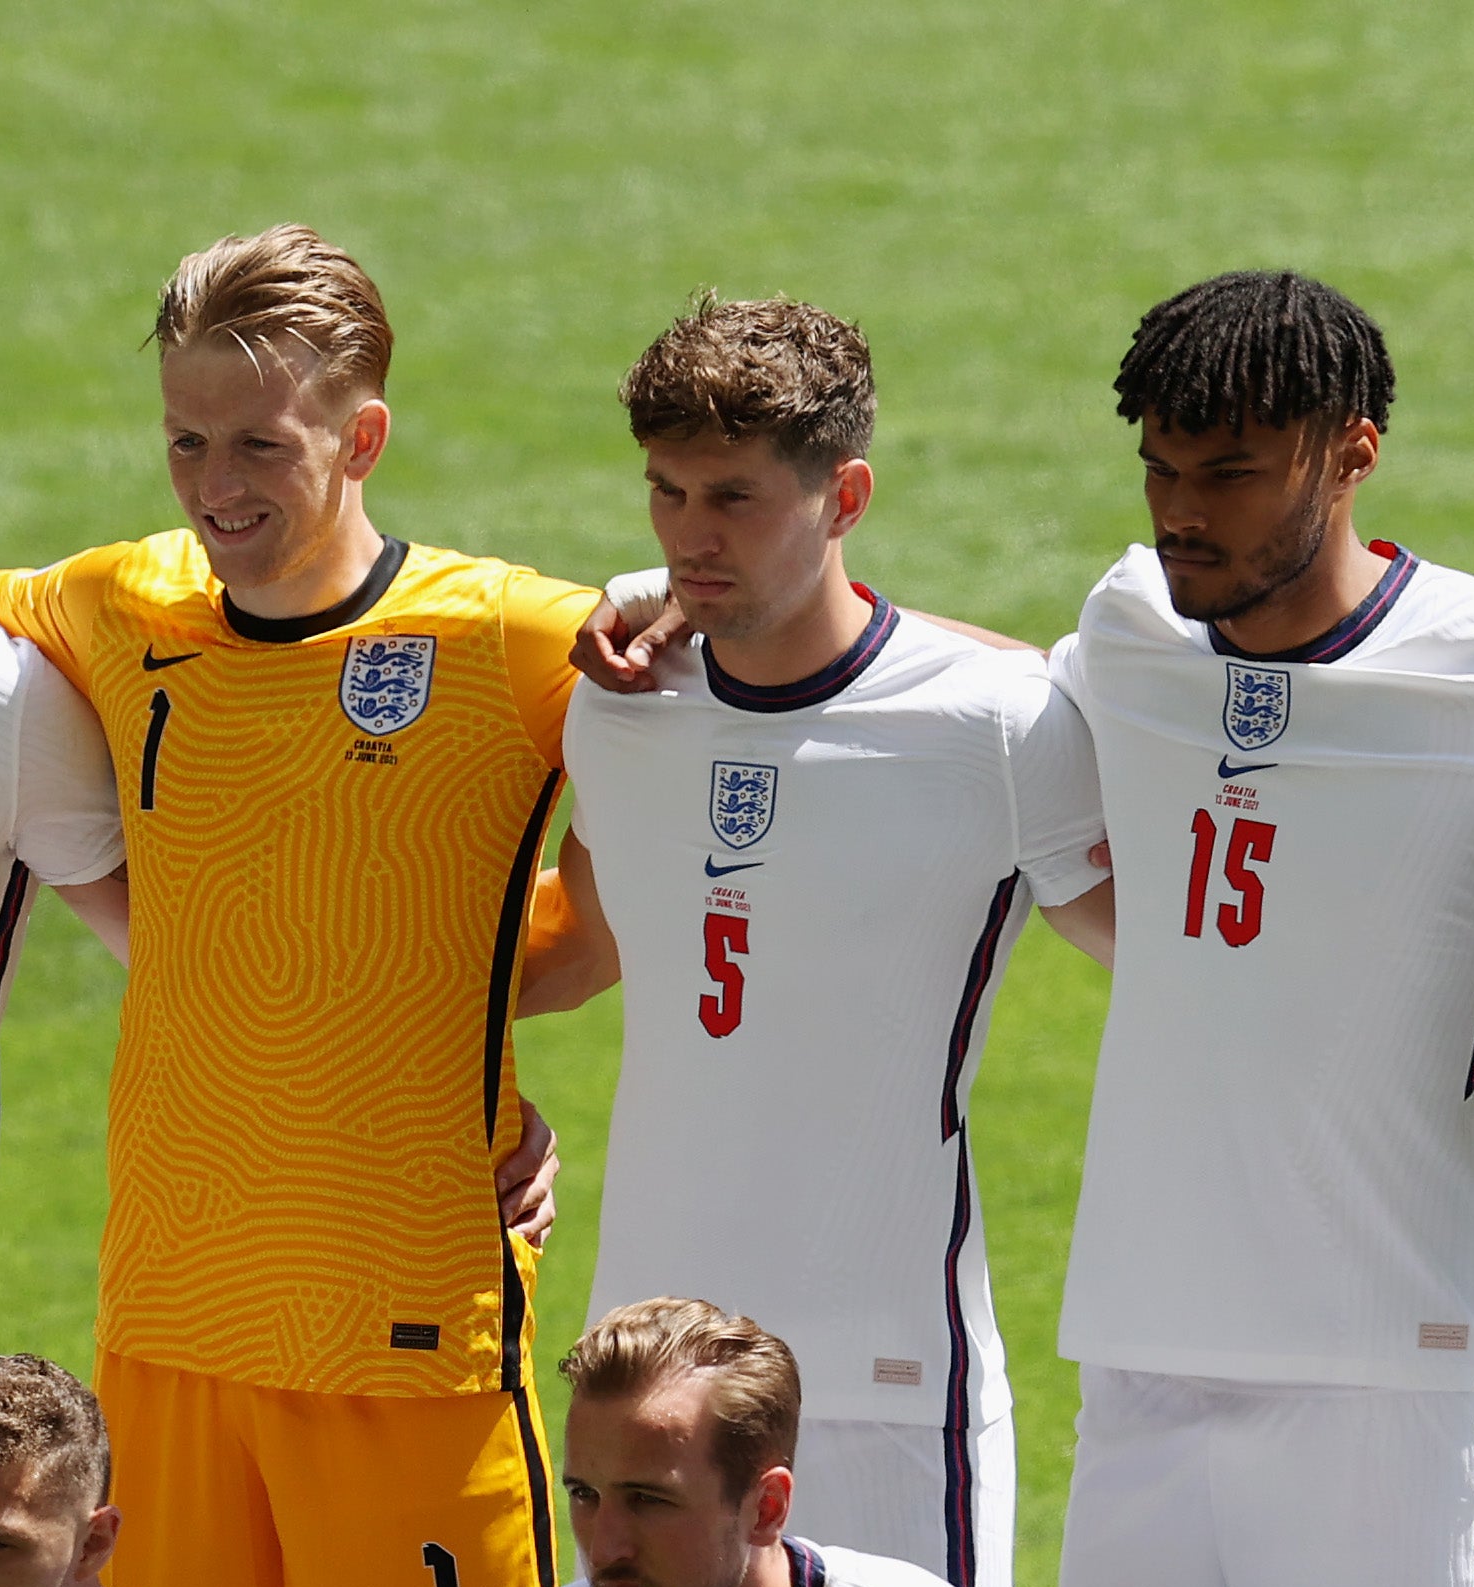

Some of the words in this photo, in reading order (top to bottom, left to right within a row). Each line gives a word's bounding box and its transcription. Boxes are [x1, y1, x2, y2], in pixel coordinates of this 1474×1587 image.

[140, 687, 171, 811] 1
[1223, 784, 1257, 799] CROATIA
[1184, 808, 1277, 948] 15
[698, 912, 750, 1038] 5
